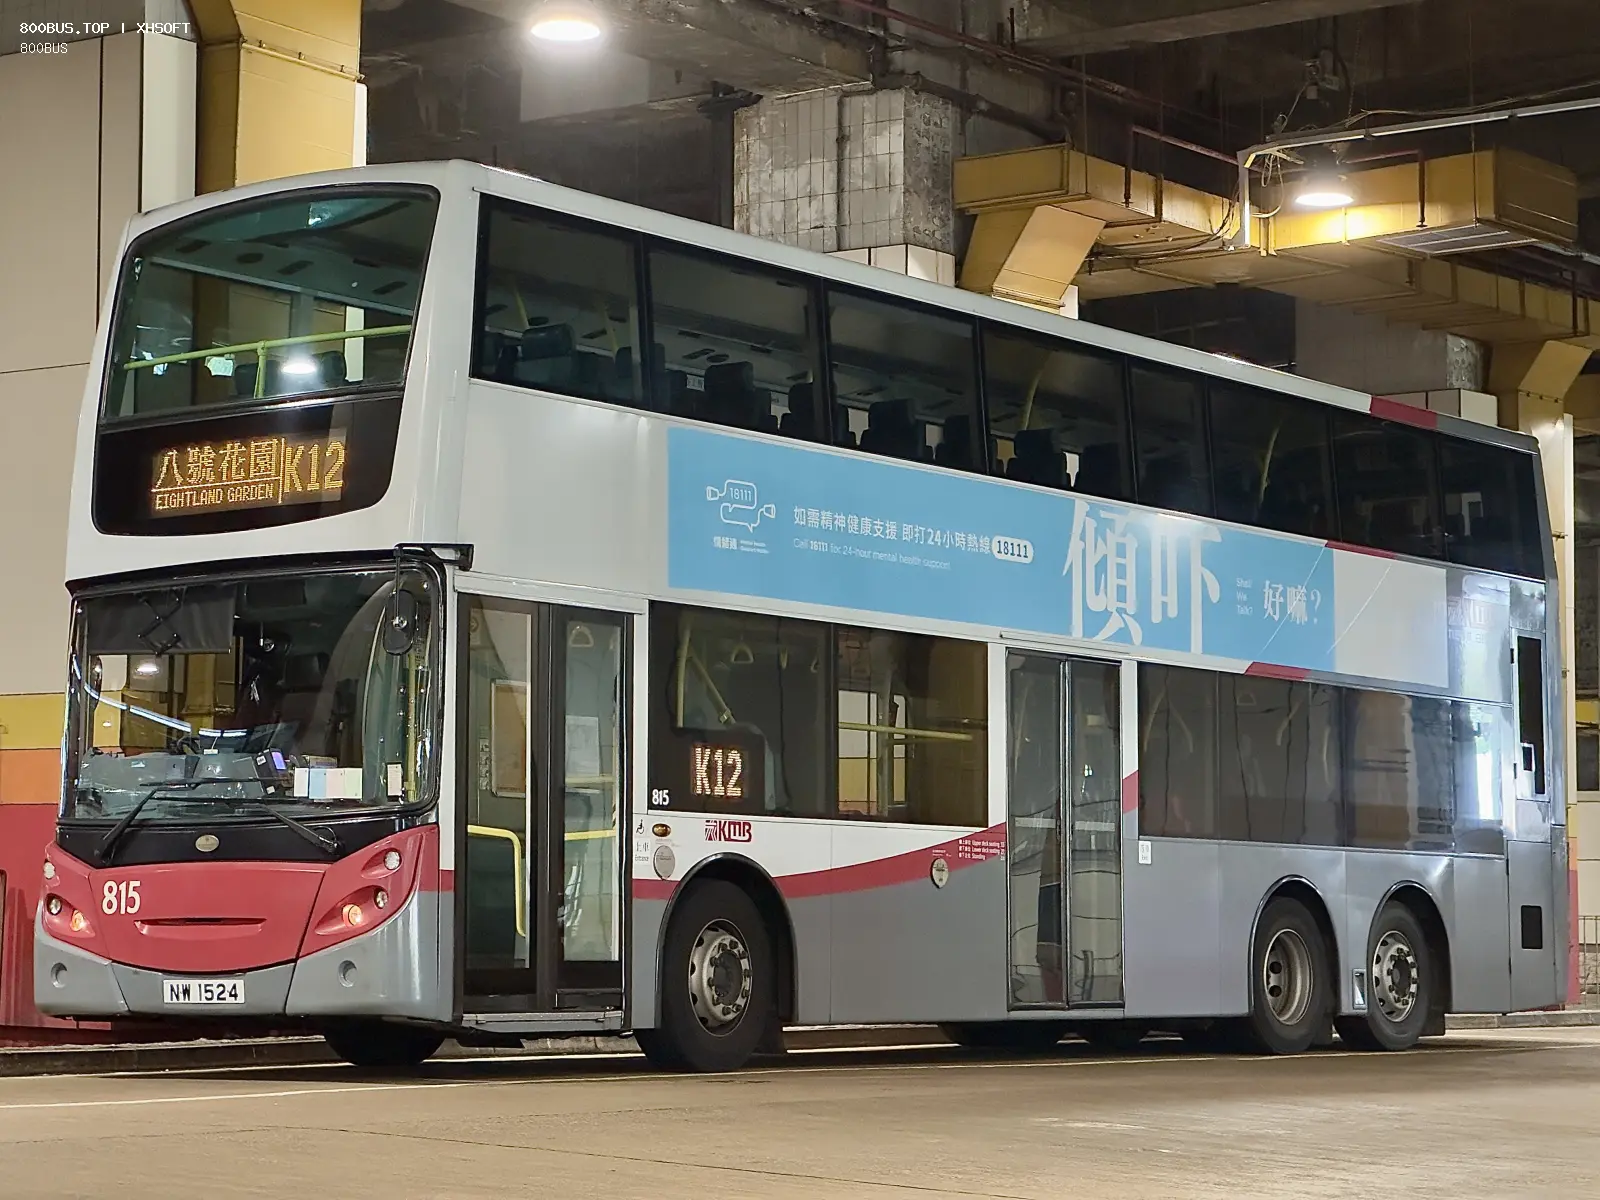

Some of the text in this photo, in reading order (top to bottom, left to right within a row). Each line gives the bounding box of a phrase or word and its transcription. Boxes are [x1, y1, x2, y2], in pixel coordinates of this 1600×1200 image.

[156, 438, 278, 488] 八號花園
[283, 441, 345, 493] K12
[155, 483, 274, 510] EIGHTLAND GARDEN
[730, 487, 752, 502] 18111
[793, 505, 1029, 559] 如需精神健康支援 即打24小時熱線 18111
[695, 747, 742, 797] K12
[652, 789, 669, 806] 815
[102, 880, 142, 915] 815
[170, 983, 239, 1002] NW 1524
